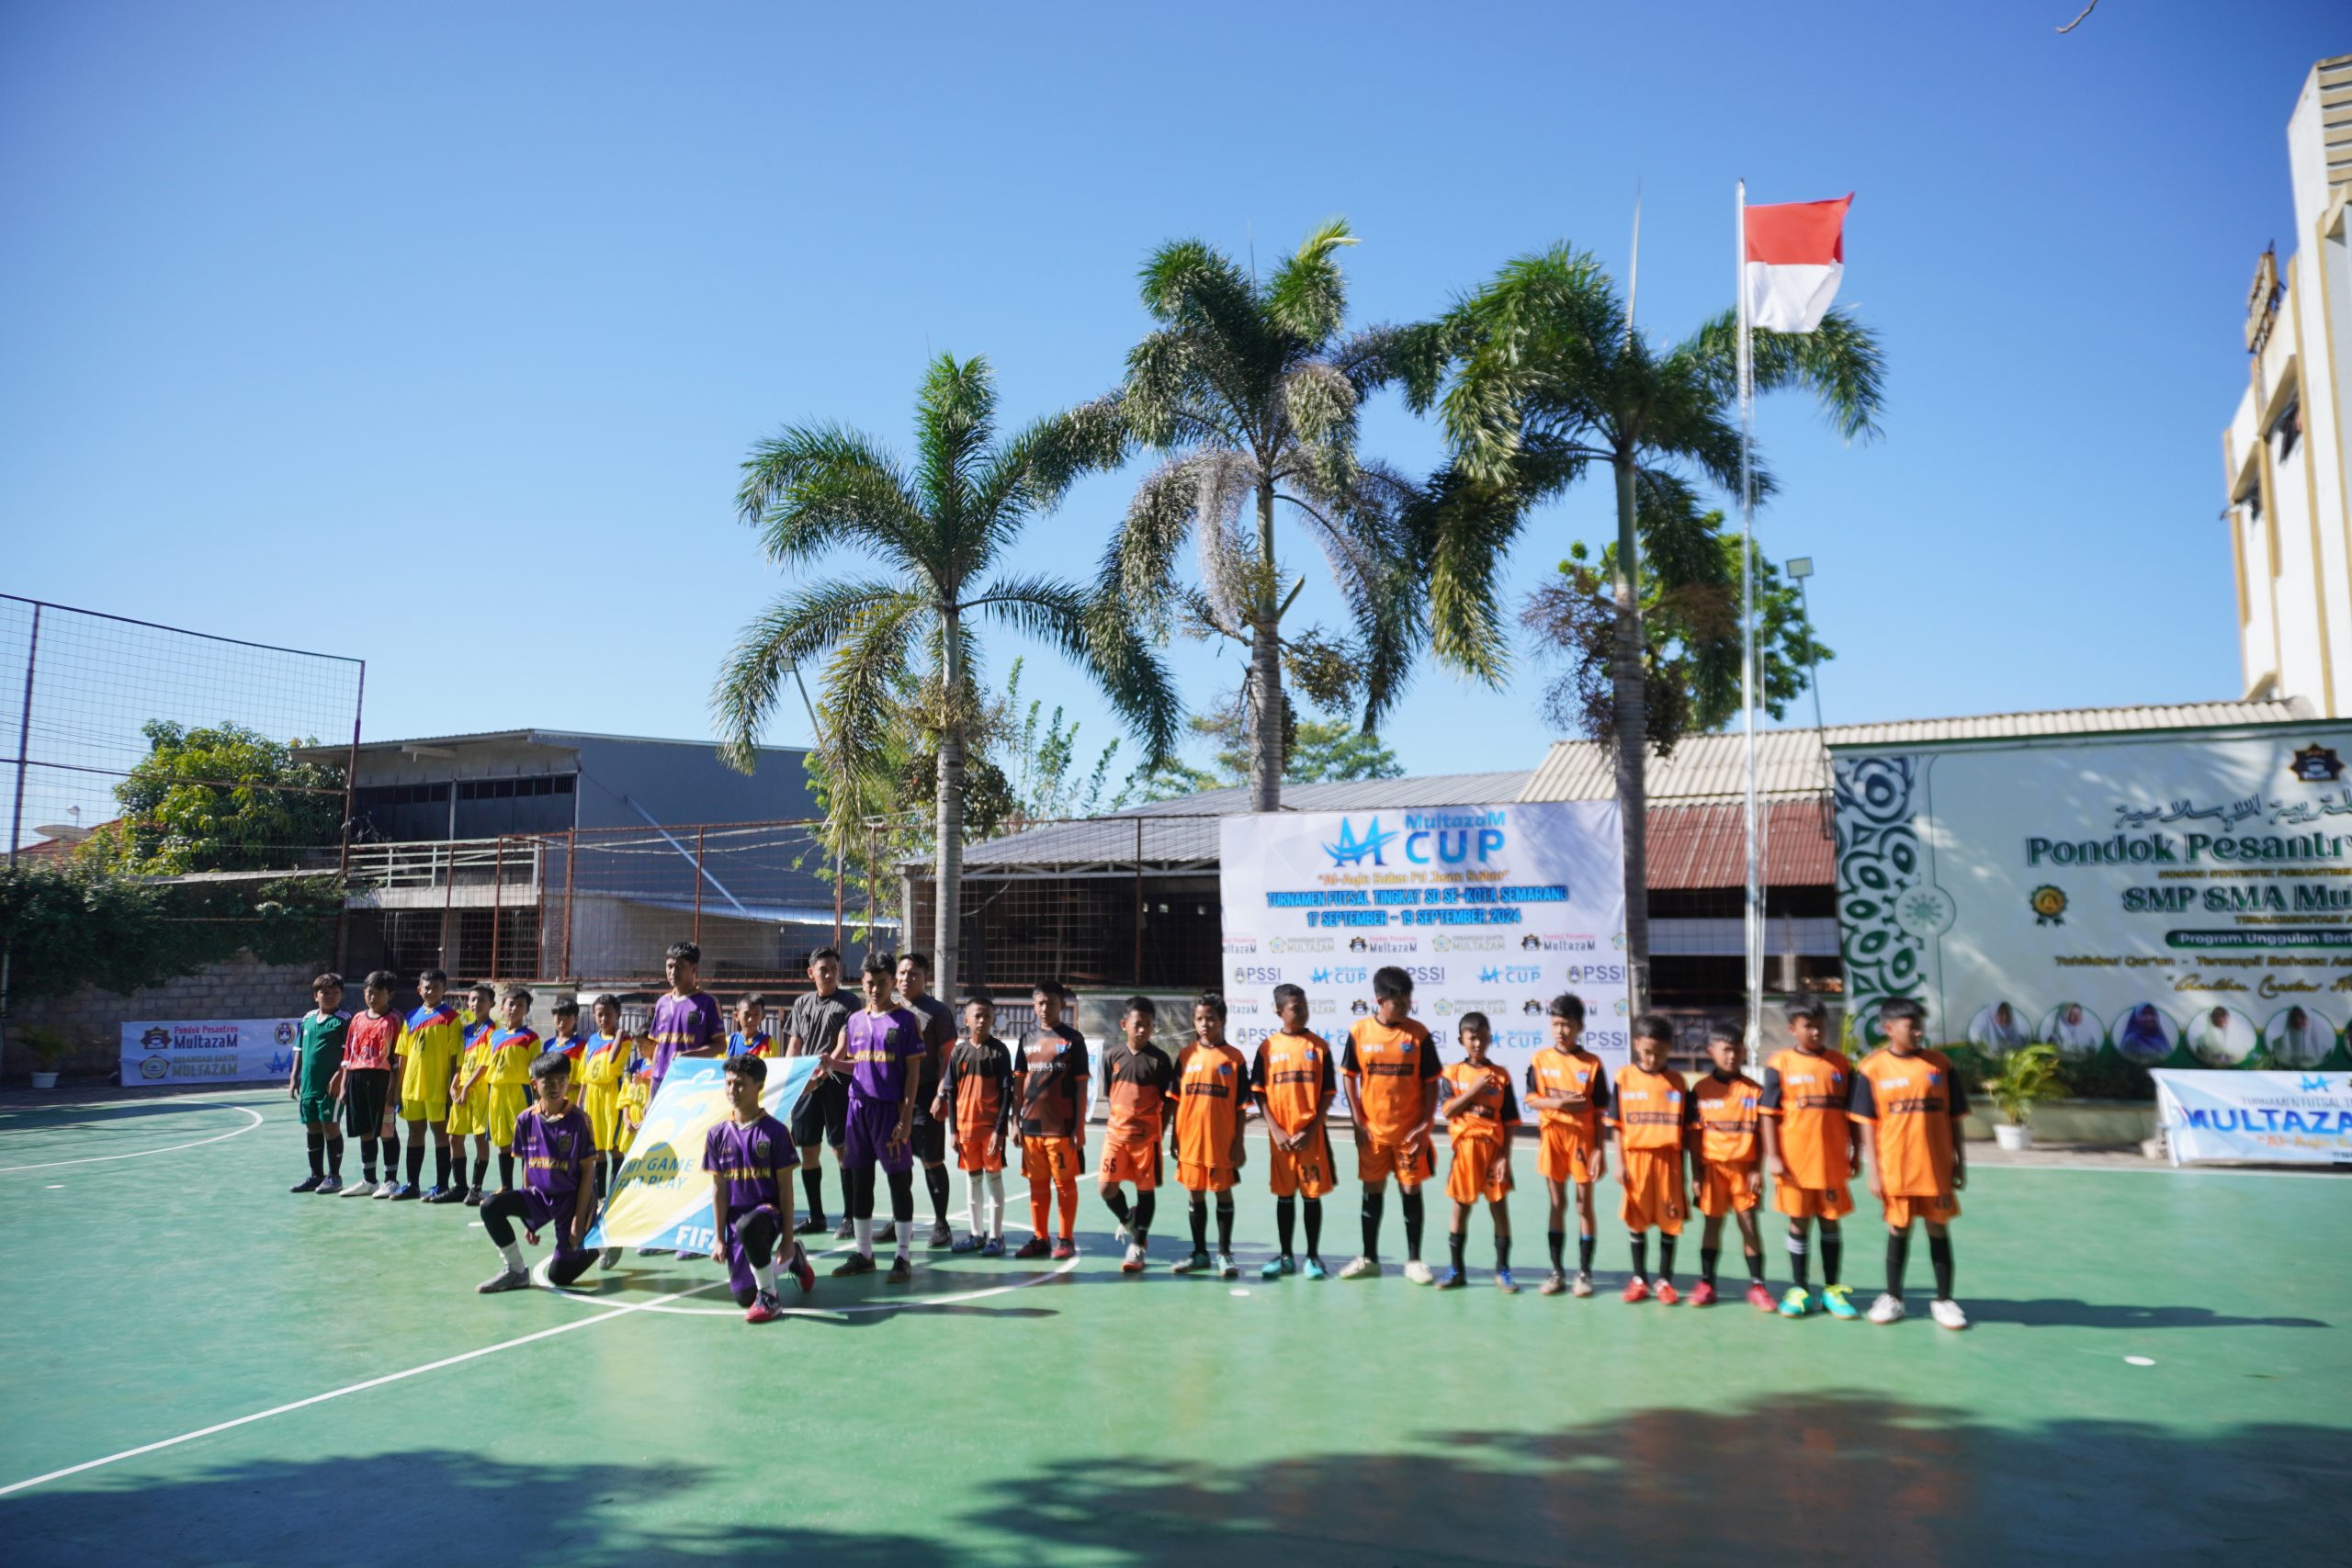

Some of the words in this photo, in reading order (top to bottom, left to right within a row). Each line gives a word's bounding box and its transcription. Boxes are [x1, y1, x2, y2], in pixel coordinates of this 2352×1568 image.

[1406, 811, 1507, 829] MultazaM
[1406, 829, 1506, 864] CUP
[2026, 833, 2178, 867] Pondok
[2184, 830, 2352, 864] Pesantr
[1266, 891, 1326, 908] TURNAMEN
[1328, 890, 1371, 907] FUTSAL
[1373, 889, 1422, 906] TINGKAT
[1425, 888, 1441, 905] SD
[1499, 885, 1568, 903] SEMARANG
[2122, 886, 2198, 913] SMP
[2204, 885, 2289, 912] SMA
[2294, 884, 2352, 911] Mu
[1307, 911, 1319, 927] 17
[1321, 910, 1388, 927] SEPTEMBER
[1401, 909, 1414, 926] 19
[1417, 908, 1487, 925] SEPTEMBER
[1488, 908, 1521, 924] 2024
[1544, 941, 1595, 951] MultazaM
[2179, 933, 2242, 946] Program
[2246, 932, 2319, 945] Unggulan
[1223, 944, 1257, 953] ultazaM
[1369, 942, 1417, 953] MultazaM
[1247, 967, 1281, 981] PSSI
[1335, 972, 1367, 984] CUP
[1406, 966, 1445, 980] PSSI
[1506, 971, 1541, 983] CUP
[1584, 965, 1625, 980] PSSI
[174, 1026, 199, 1034] Pondok
[202, 1025, 239, 1034] Pesantren
[174, 1034, 238, 1049] MultazaM
[1508, 1036, 1542, 1048] CUP
[1586, 1032, 1627, 1046] PSSI
[172, 1063, 238, 1077] MULTAZAM
[2181, 1106, 2352, 1134] MULTAZA
[625, 1159, 642, 1175] MY
[647, 1157, 695, 1174] GAME
[1057, 1152, 1066, 1169] 1
[648, 1176, 688, 1190] PLAY
